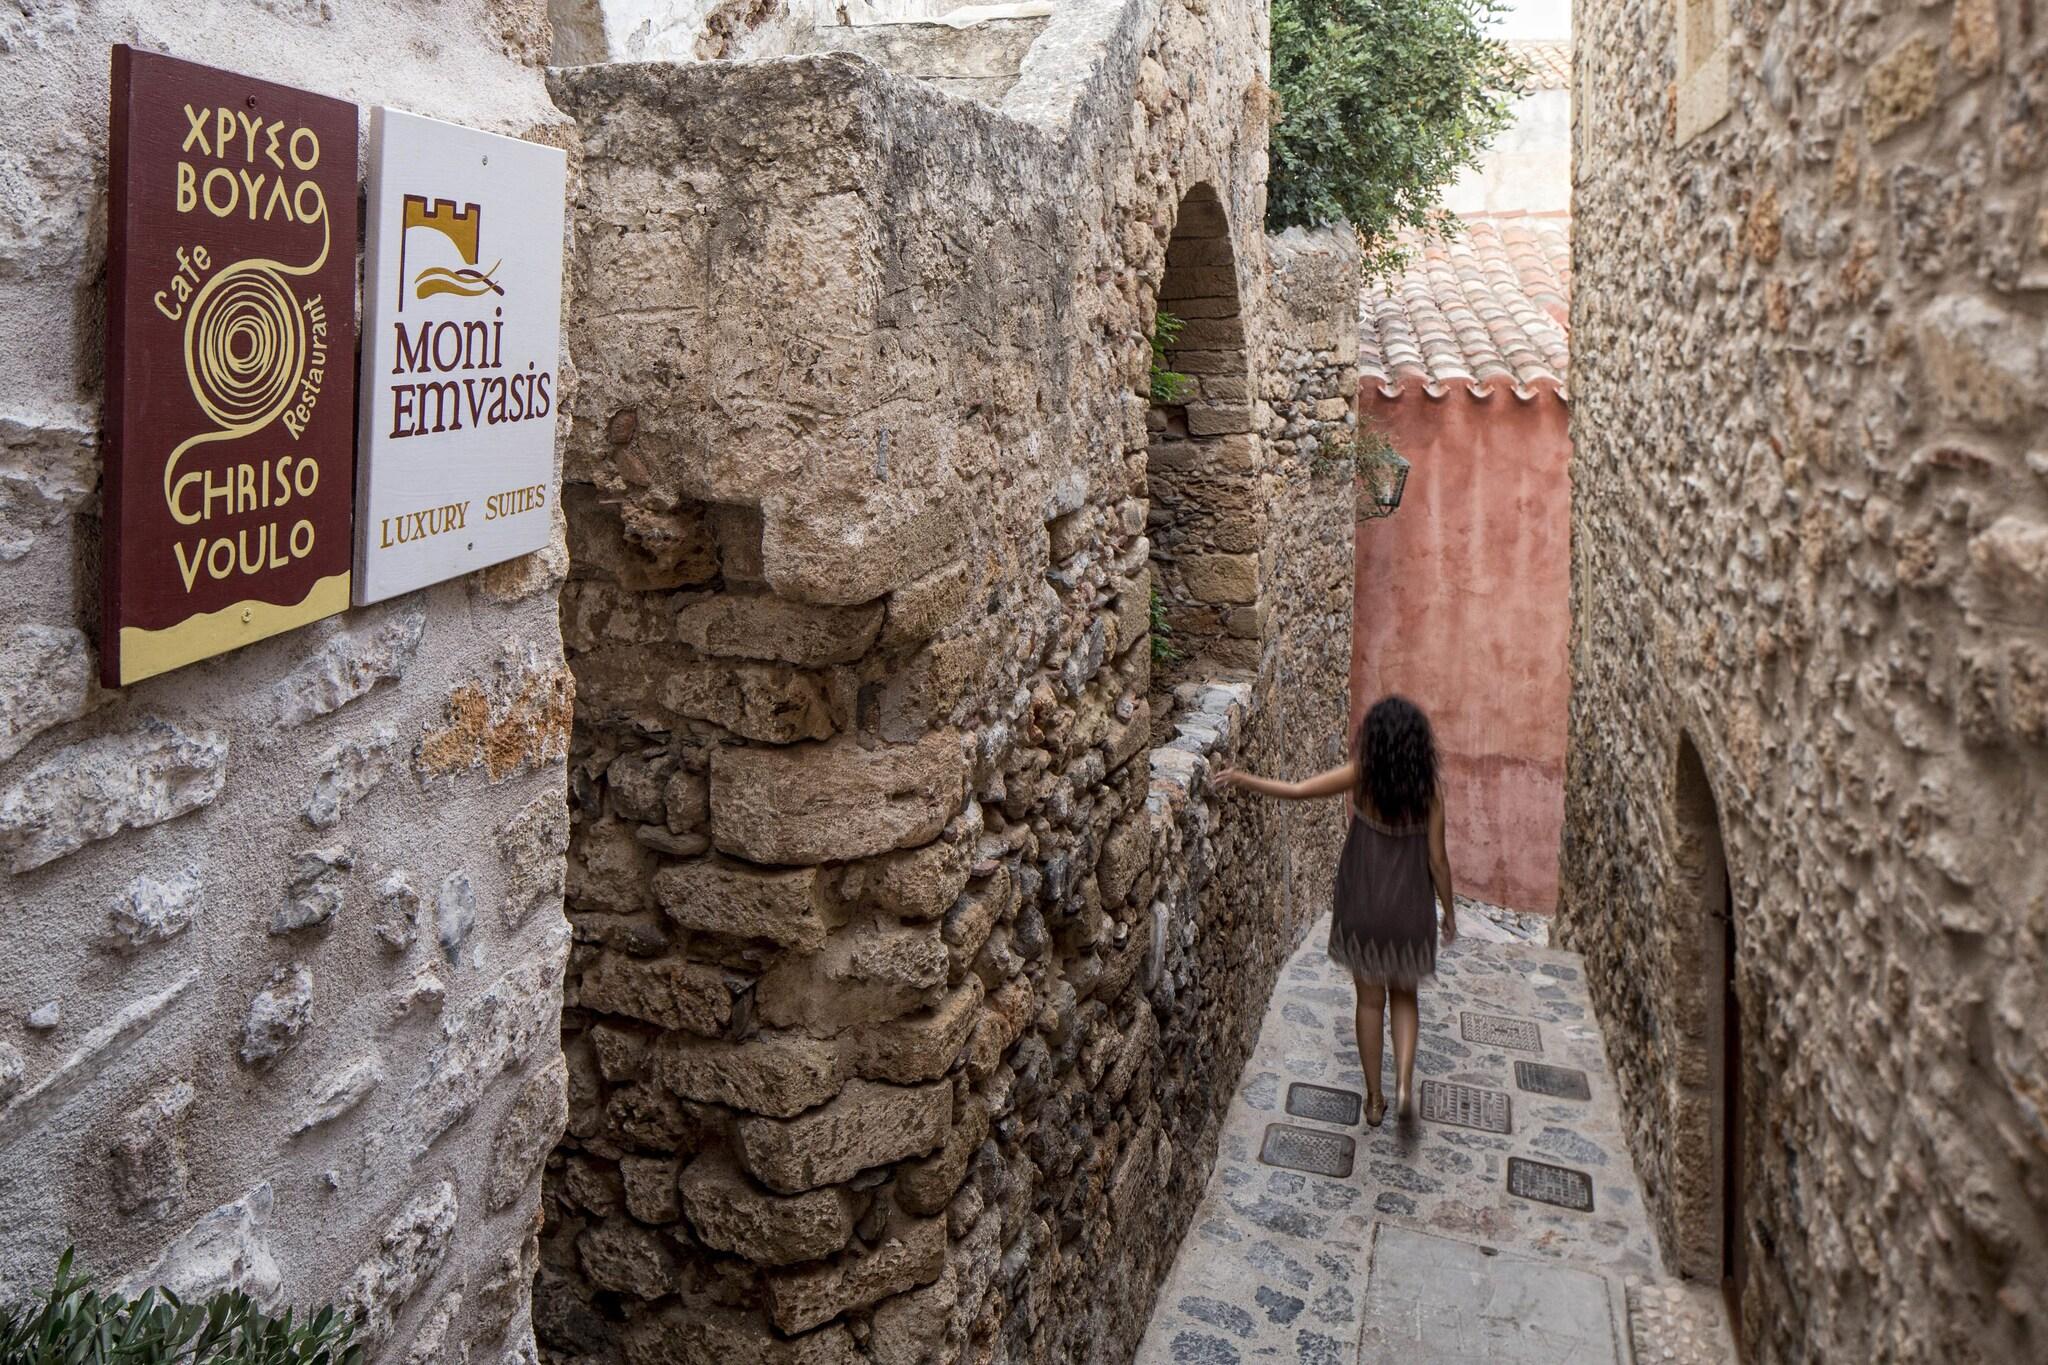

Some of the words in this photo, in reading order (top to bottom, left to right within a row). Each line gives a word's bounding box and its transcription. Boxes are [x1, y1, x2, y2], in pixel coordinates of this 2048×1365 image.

[182, 103, 320, 170] ΧΡΥΣΟ
[177, 161, 325, 224] ΒΟΥΛΟ
[154, 245, 212, 321] Cafe
[282, 293, 328, 441] Restaurant
[389, 361, 551, 439] Emvasis
[170, 455, 320, 525] CHRISO
[380, 500, 471, 549] LUXURY
[485, 483, 547, 521] SUITES
[173, 519, 315, 593] VOULO
